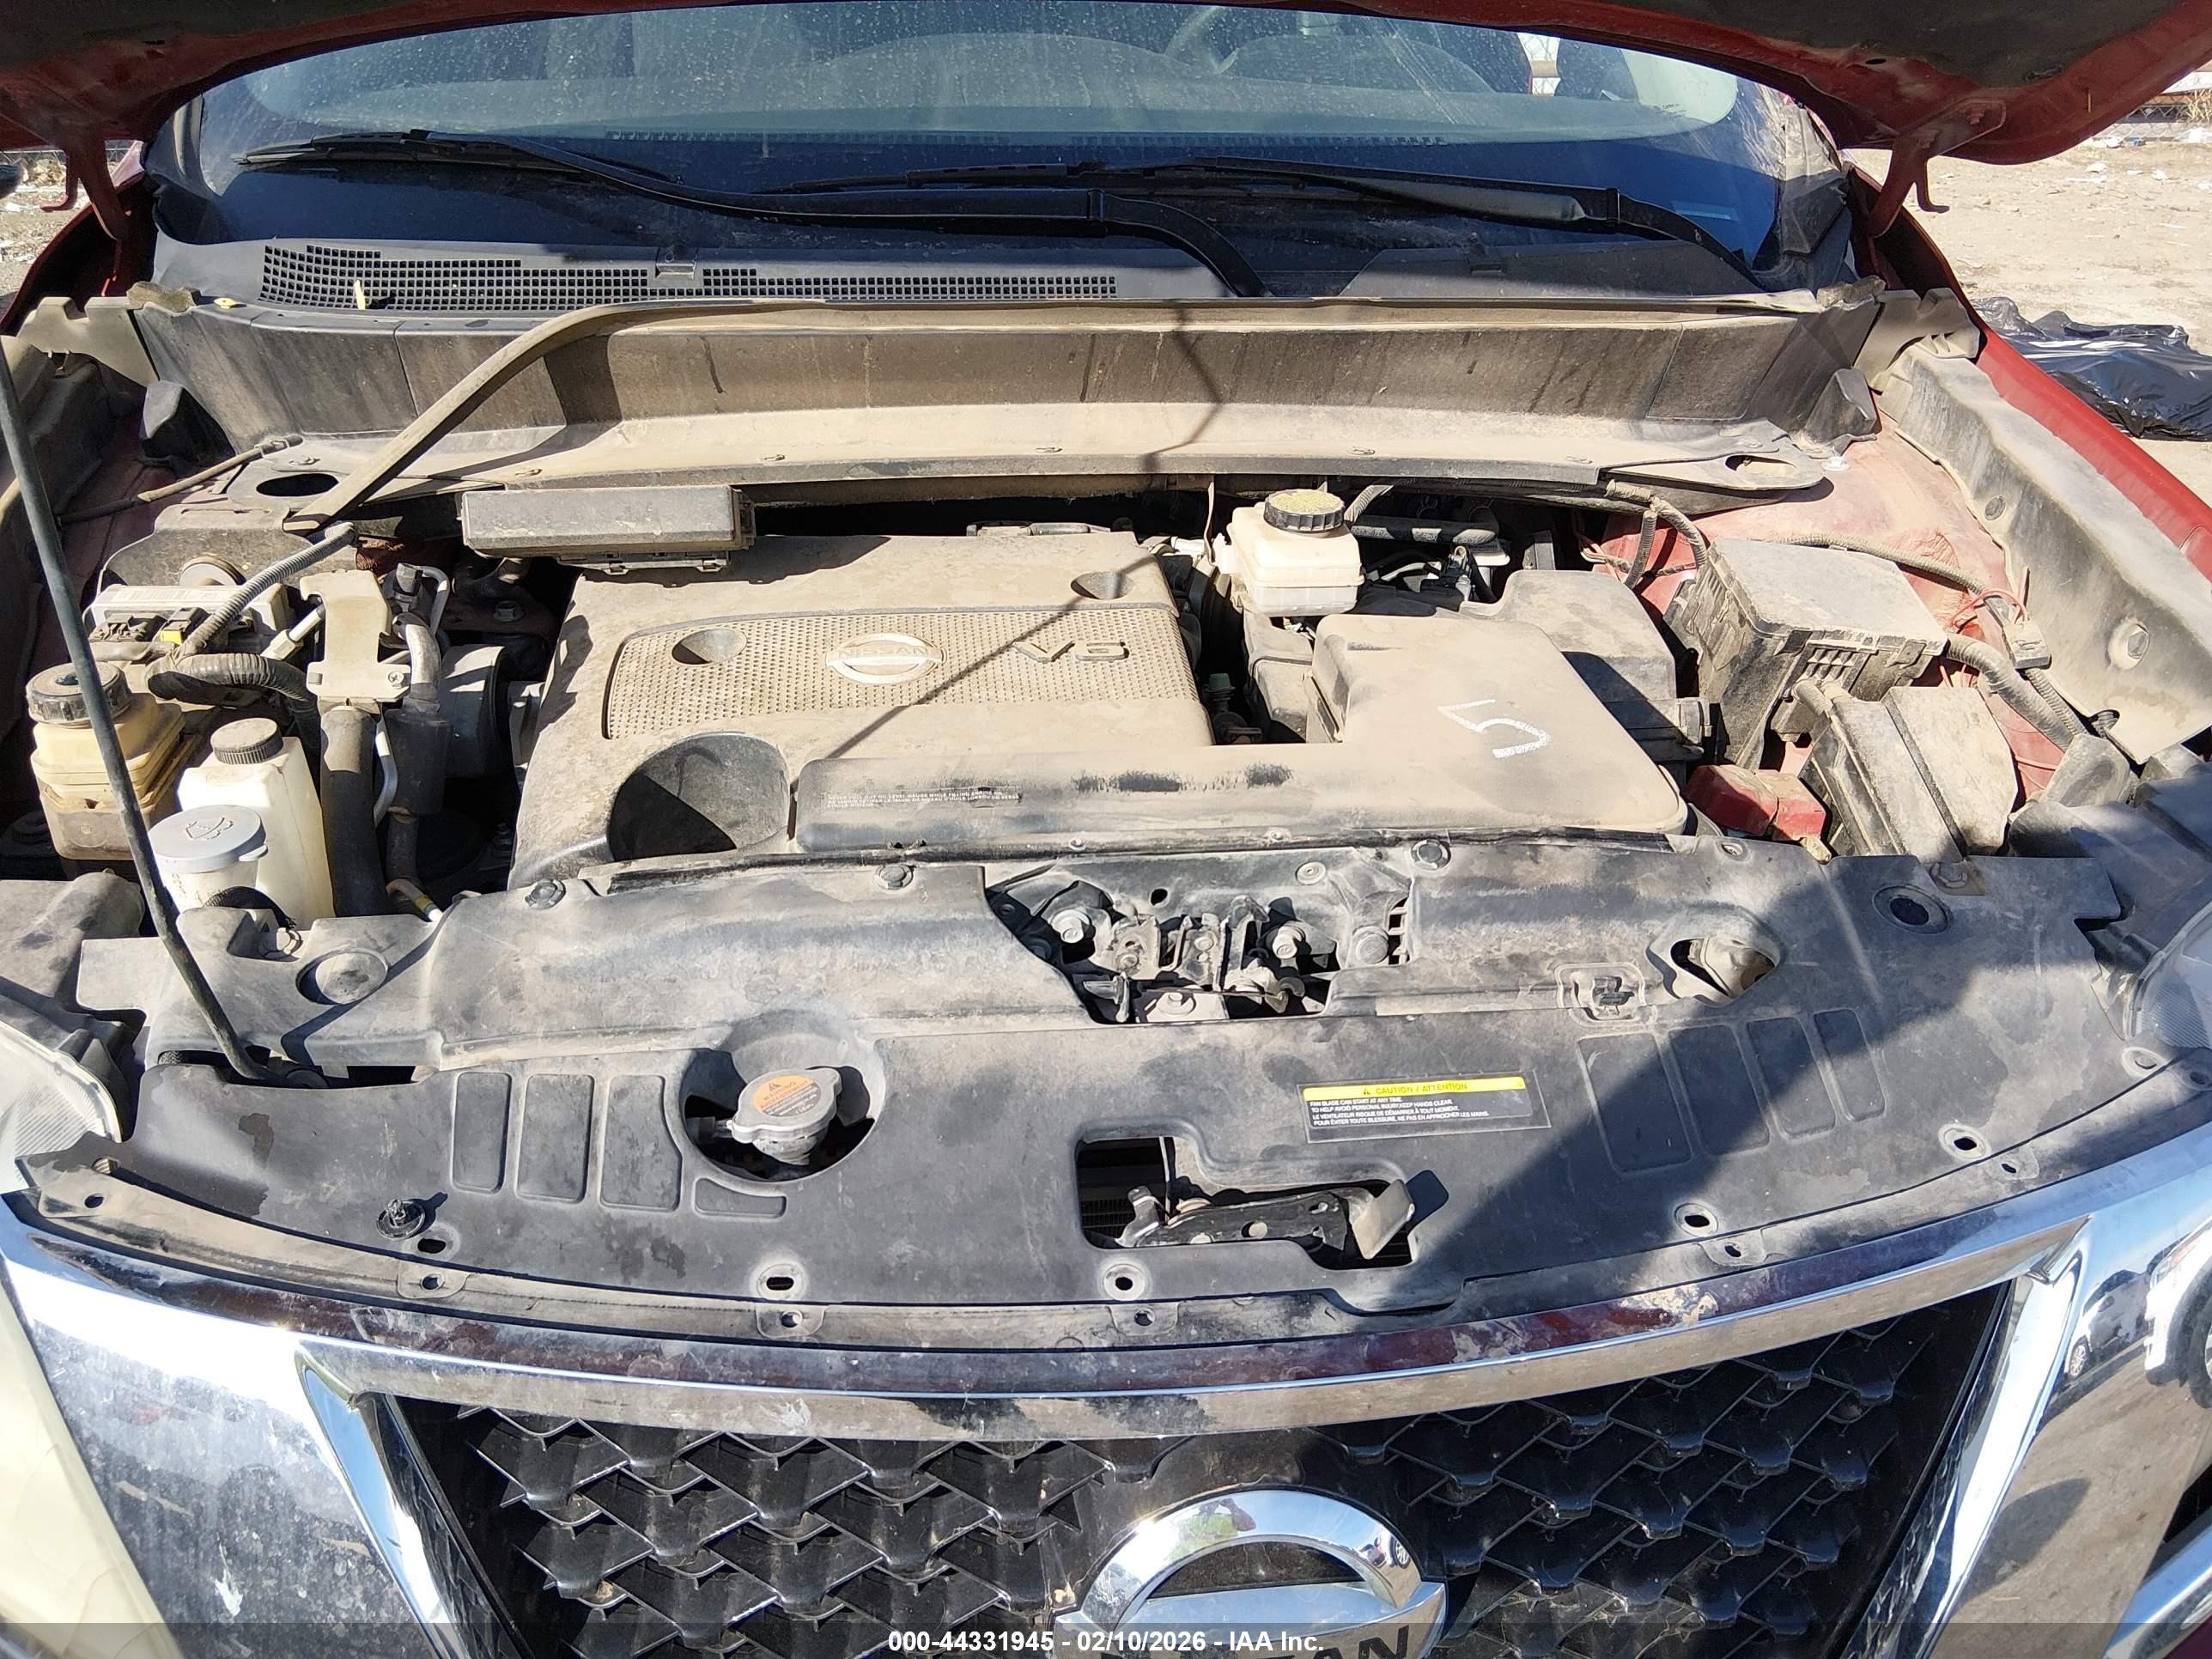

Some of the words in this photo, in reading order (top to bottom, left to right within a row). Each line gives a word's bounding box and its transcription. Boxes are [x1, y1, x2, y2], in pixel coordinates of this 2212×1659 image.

[839, 647, 927, 660] NISSAN
[1012, 641, 1130, 663] V6
[1438, 698, 1553, 759] 5
[1376, 1086, 1413, 1095] CAUTION
[1422, 1082, 1468, 1092] ATTENTION
